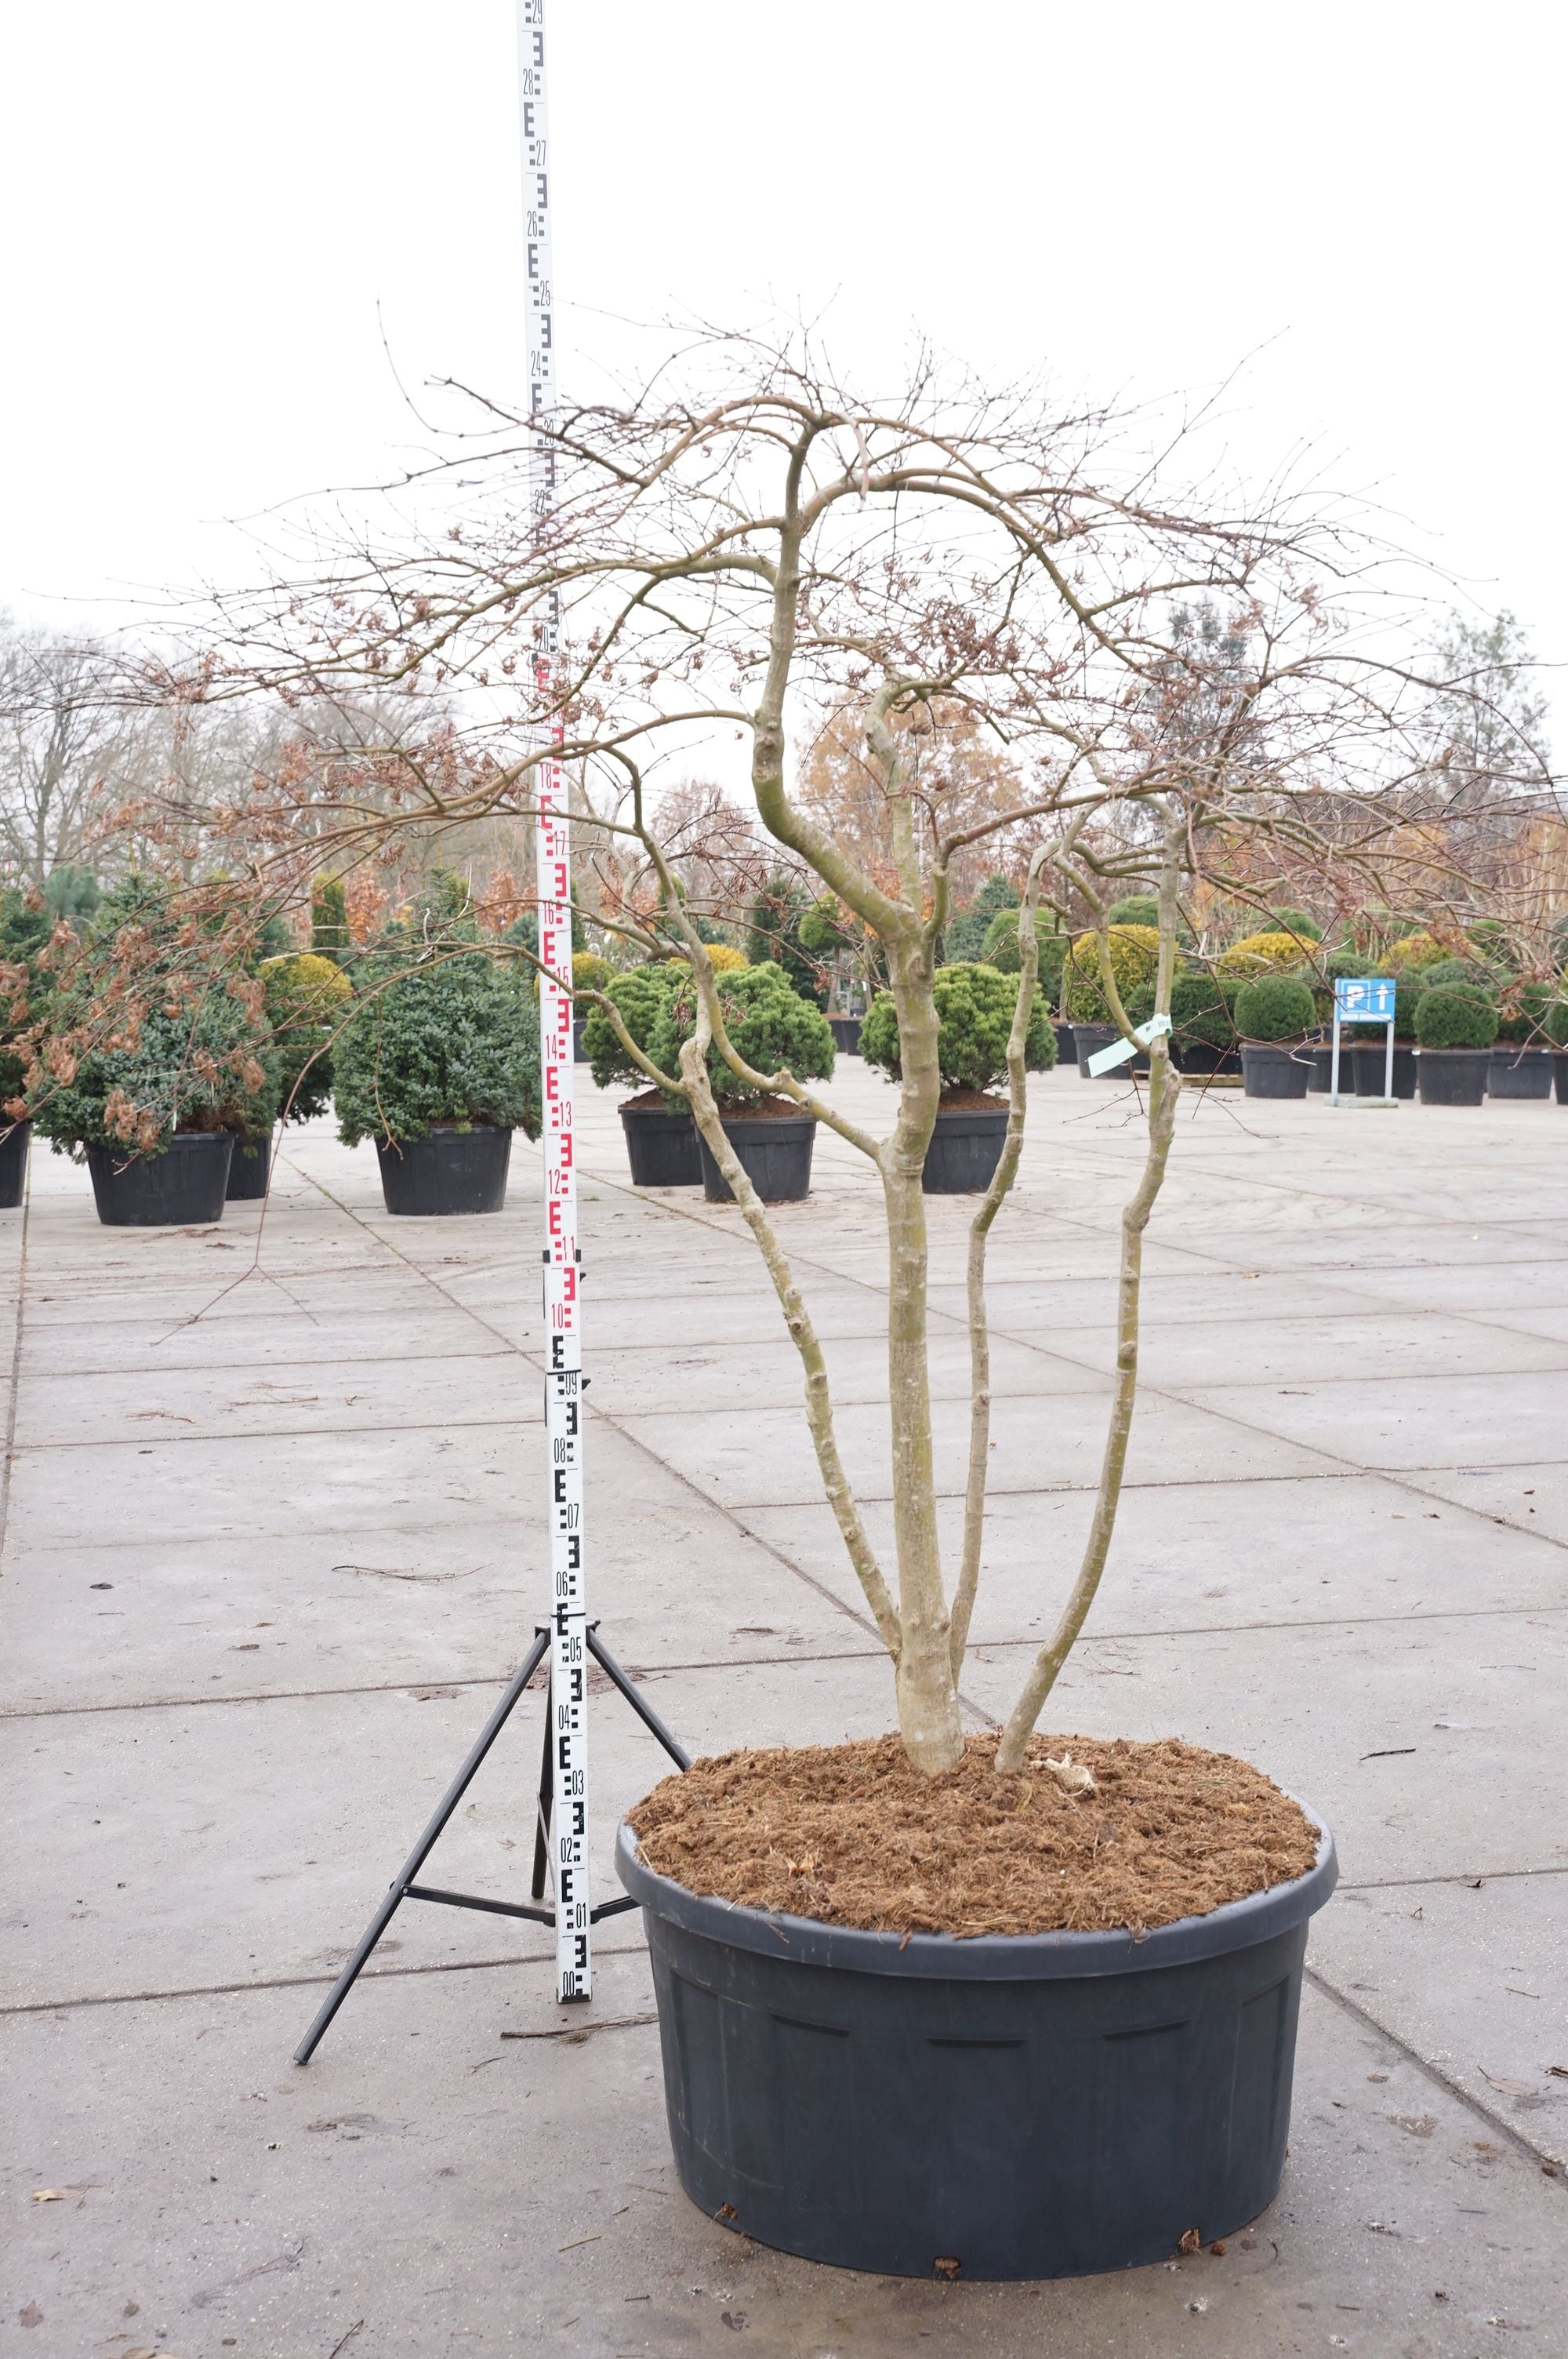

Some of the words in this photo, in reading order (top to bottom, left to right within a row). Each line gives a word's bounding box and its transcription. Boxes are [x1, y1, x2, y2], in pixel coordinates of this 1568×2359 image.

[532, 0, 543, 24] 29
[523, 68, 534, 95] 28
[536, 140, 546, 166] 27
[527, 211, 537, 236] 26
[540, 280, 550, 307] 25
[531, 351, 541, 376] 24
[540, 763, 551, 789] 18
[554, 831, 565, 856] 17
[543, 900, 554, 925] 16
[557, 966, 568, 991] 15
[1347, 985, 1365, 1009] P
[546, 1034, 557, 1060] 14
[559, 1101, 572, 1127] 13
[548, 1169, 561, 1194] 12
[562, 1236, 575, 1261] 11
[552, 1303, 563, 1329] 10
[565, 1372, 577, 1395] 09
[554, 1438, 565, 1463] 08
[568, 1503, 579, 1529] 07
[557, 1571, 568, 1596] 06
[570, 1637, 581, 1662] 05
[559, 1705, 570, 1730] 04
[572, 1770, 583, 1795] 03
[561, 1837, 572, 1863] 02
[576, 1902, 586, 1928] 01
[563, 1971, 574, 1996] 00
